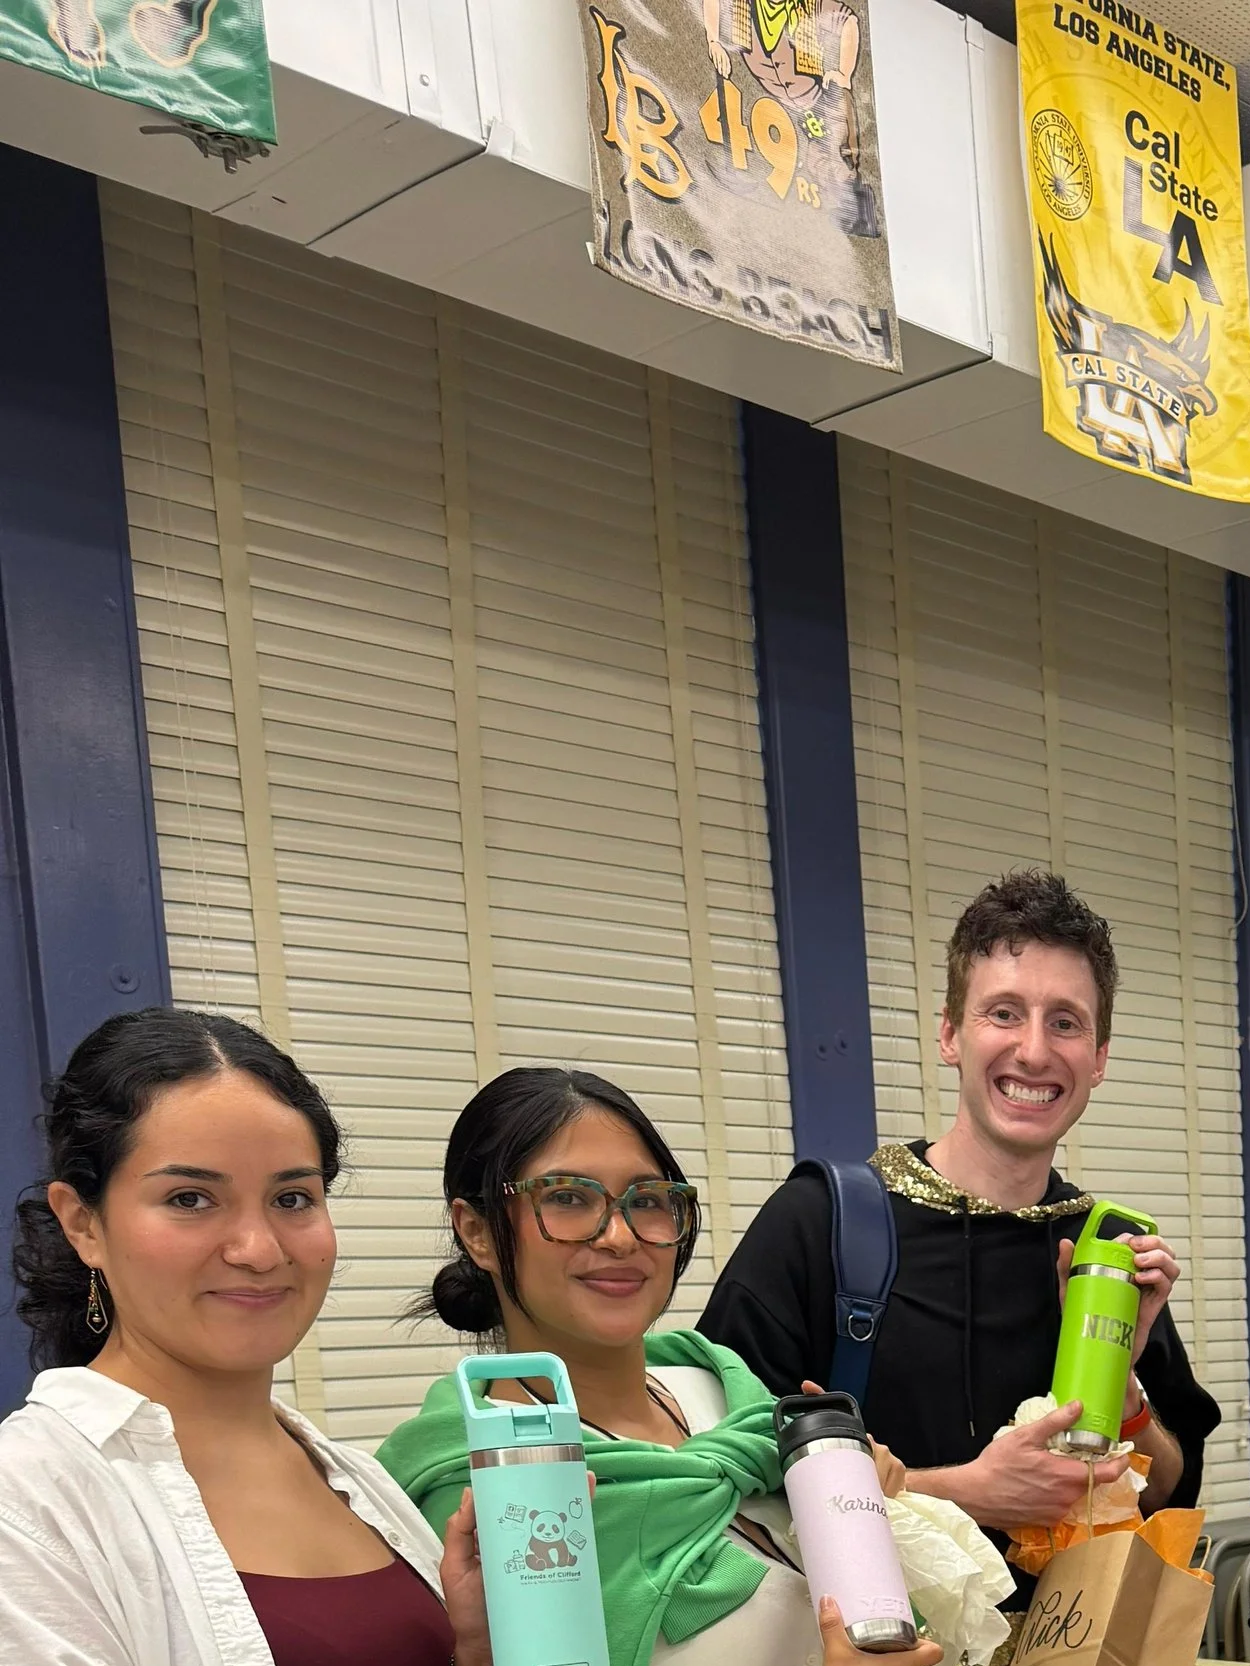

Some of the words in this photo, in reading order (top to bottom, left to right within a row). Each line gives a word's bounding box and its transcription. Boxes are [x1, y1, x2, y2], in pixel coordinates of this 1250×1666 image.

[1053, 3, 1100, 46] LOS
[1106, 31, 1202, 103] ANGELES
[1164, 30, 1231, 92] STATE,
[1125, 110, 1180, 169] Cal
[1148, 161, 1219, 222] State
[1123, 156, 1224, 306] LA
[1071, 356, 1108, 378] CAL
[1116, 366, 1182, 418] STATE
[1082, 1313, 1134, 1350] NICK
[520, 1572, 546, 1581] Friends
[557, 1570, 581, 1579] Clifford
[1016, 1590, 1092, 1664] Nick
